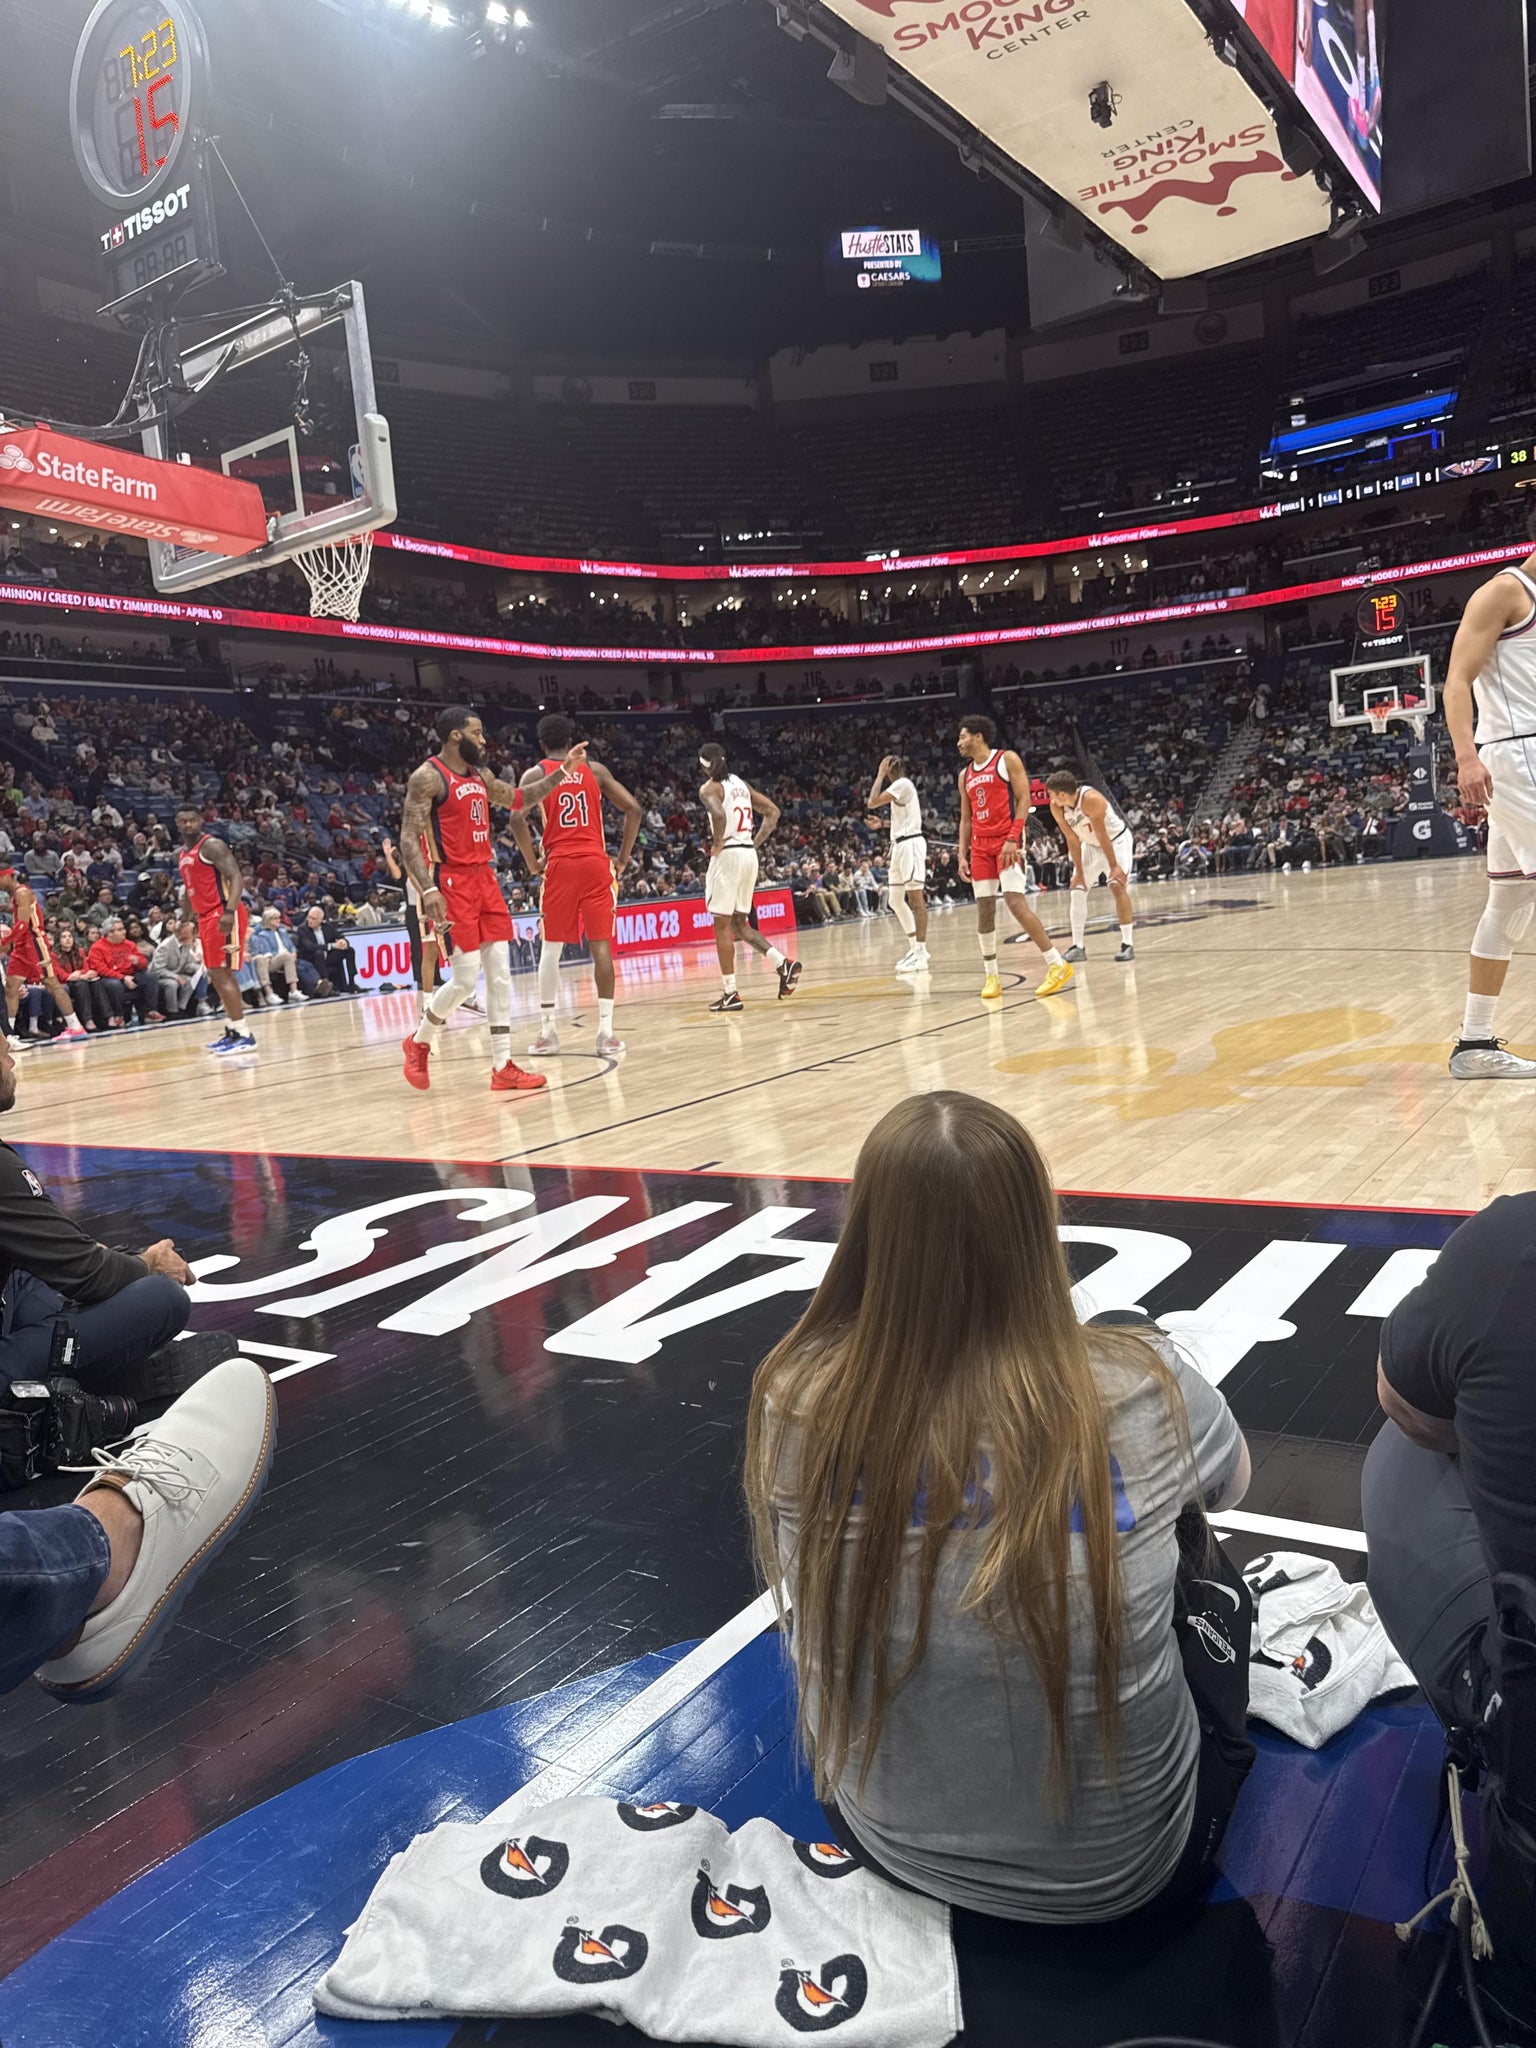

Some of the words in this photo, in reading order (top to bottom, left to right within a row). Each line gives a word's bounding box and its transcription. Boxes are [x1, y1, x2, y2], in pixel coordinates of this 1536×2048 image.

[986, 10, 1090, 60] CENTER
[119, 17, 179, 88] 7:23
[133, 74, 180, 176] 15
[1101, 119, 1195, 159] CENTER
[1077, 124, 1267, 201] SMOOTHIE
[123, 183, 191, 240] TISSOT
[871, 271, 911, 281] CAESARS
[1510, 449, 1528, 464] 38
[1281, 501, 1300, 512] FOULS
[1308, 498, 1314, 507] 1
[1382, 480, 1394, 491] 12
[1401, 477, 1414, 486] AST
[1424, 472, 1432, 482] 8
[1371, 570, 1400, 582] RODEO
[1405, 564, 1430, 575] JASON
[1432, 557, 1465, 570] ALDEAN
[1471, 550, 1505, 563] LYNARD
[48, 592, 82, 605] CREED
[88, 597, 121, 609] BAILEY
[123, 600, 180, 615] ZIMMERMAN
[187, 607, 211, 618] APRIL
[212, 610, 222, 619] 10
[1370, 594, 1398, 610] 7:23
[1375, 608, 1396, 631] 15
[1110, 637, 1129, 656] 117
[1373, 634, 1404, 647] TISSOT
[538, 676, 559, 694] 115
[803, 670, 823, 688] 116
[558, 790, 589, 828] 21
[975, 787, 987, 808] 3
[470, 798, 487, 826] 41
[733, 806, 752, 833] 23
[1412, 819, 1432, 840] G
[616, 911, 659, 945] MAR
[660, 909, 680, 939] 28
[693, 912, 714, 929] SMO
[757, 903, 786, 919] CENTER
[1194, 1617, 1232, 1657] PELICANS
